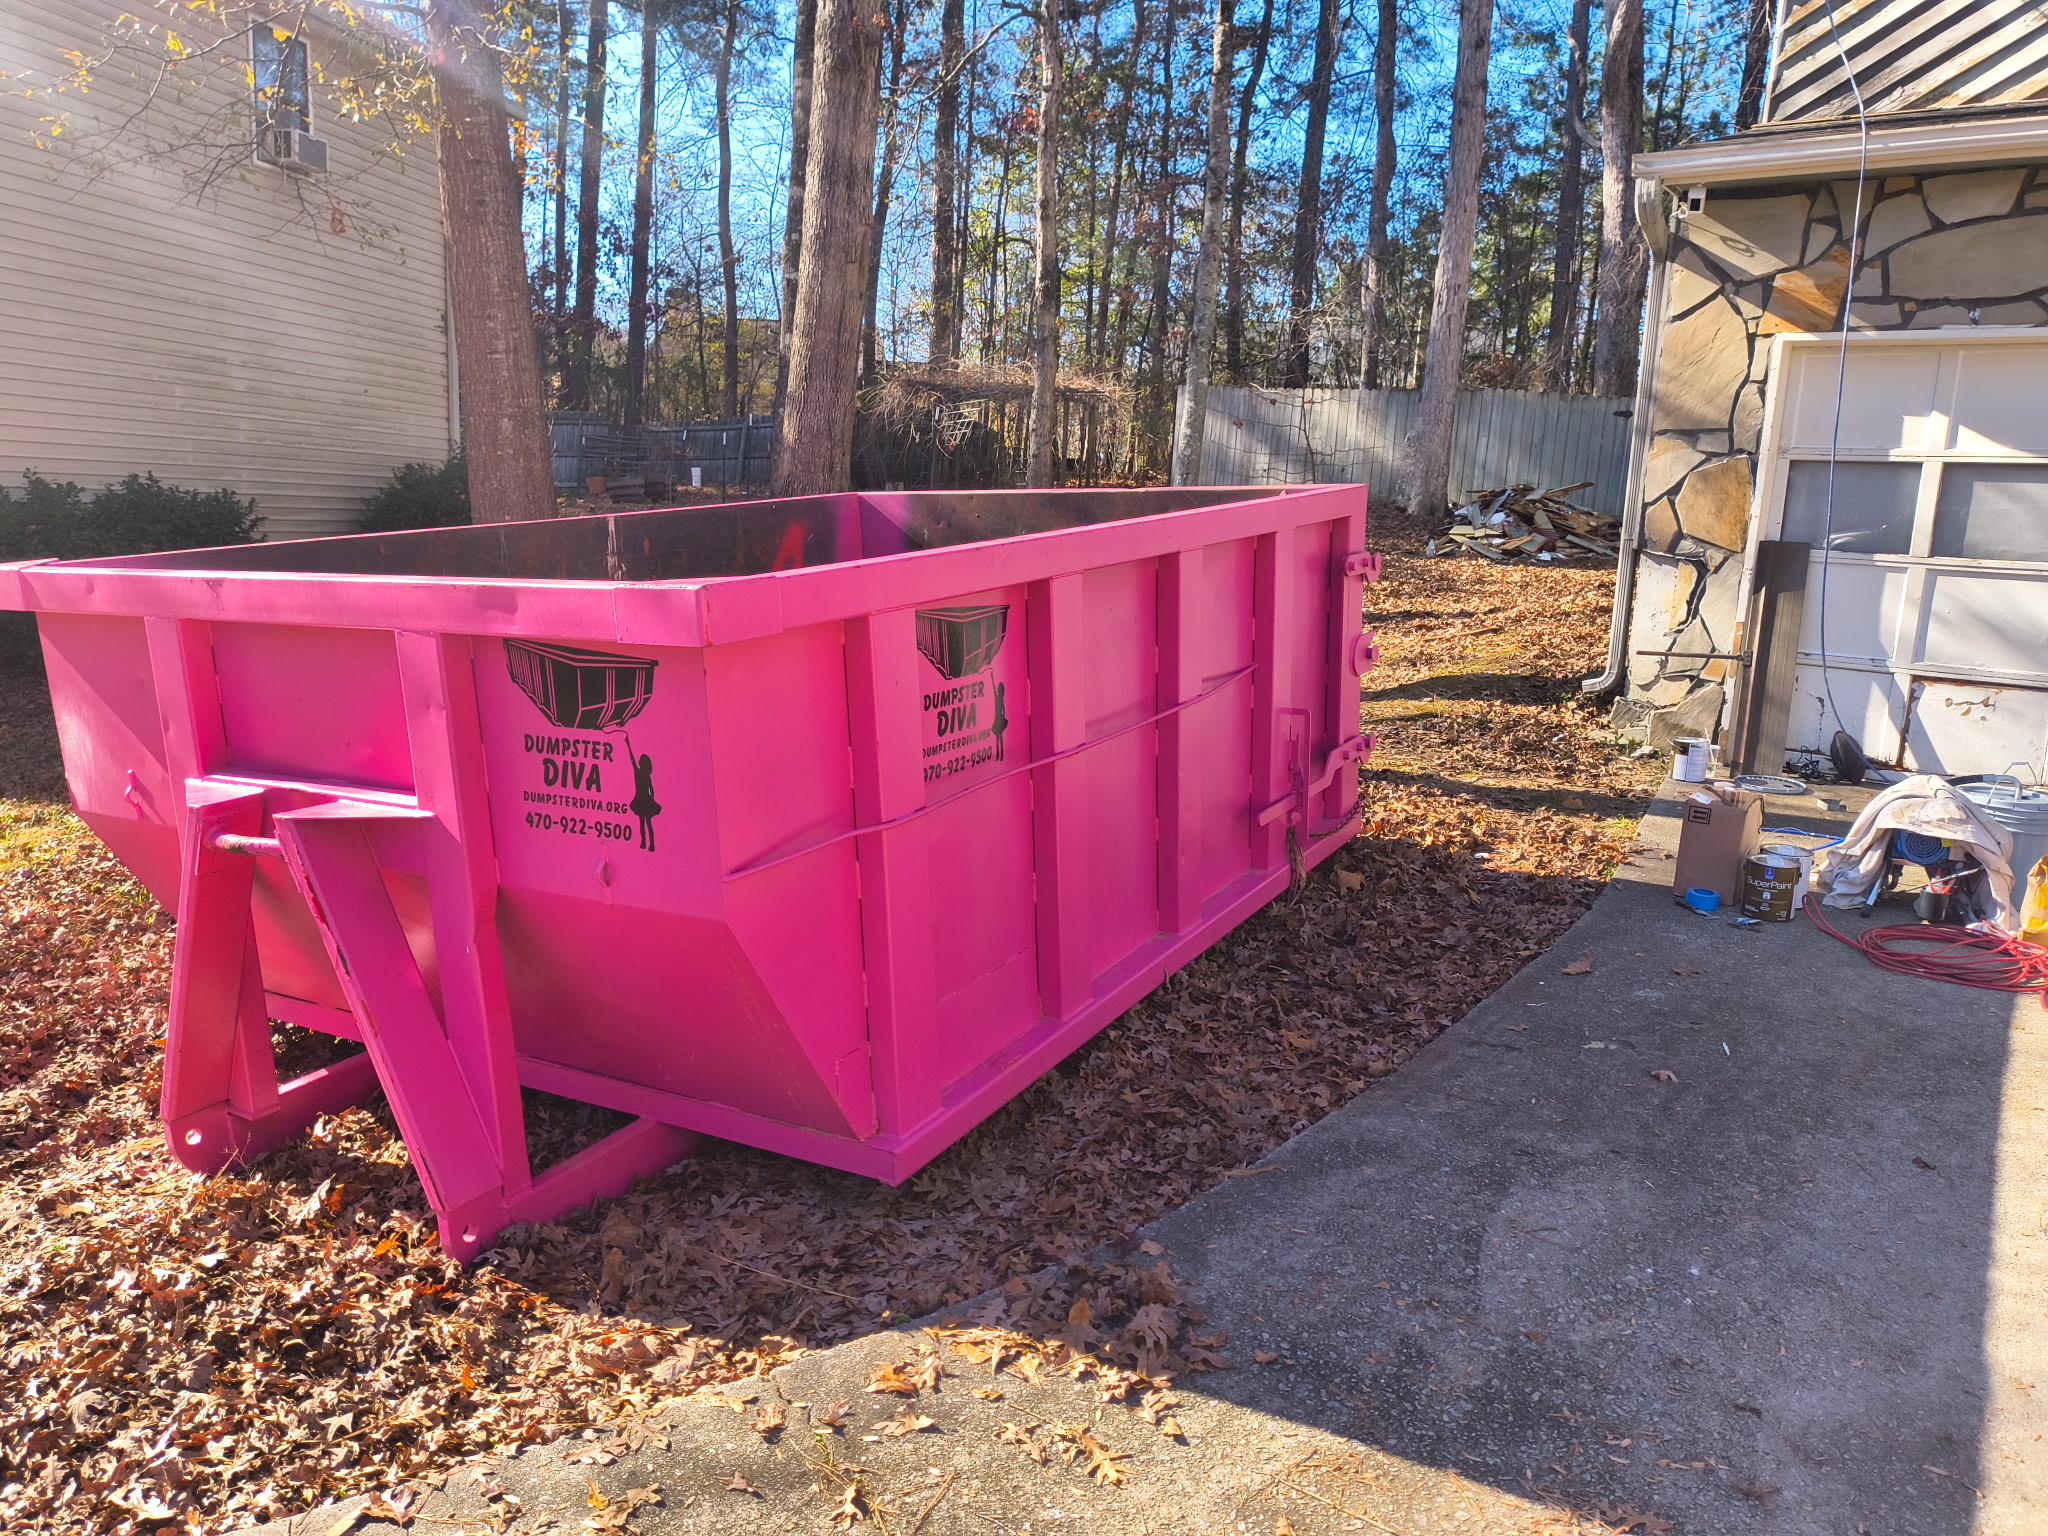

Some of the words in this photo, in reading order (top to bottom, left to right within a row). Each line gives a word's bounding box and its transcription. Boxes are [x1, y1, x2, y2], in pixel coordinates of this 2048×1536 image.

[923, 681, 985, 711] DUMPSTER
[937, 703, 977, 737] DIVA
[524, 734, 614, 763] DUMPSTER
[542, 758, 602, 793] DIVA
[523, 791, 628, 814] DUMPSTERDIVA.ORG
[525, 811, 633, 842] 470-922-9500
[1747, 875, 1792, 890] SuperPaint
